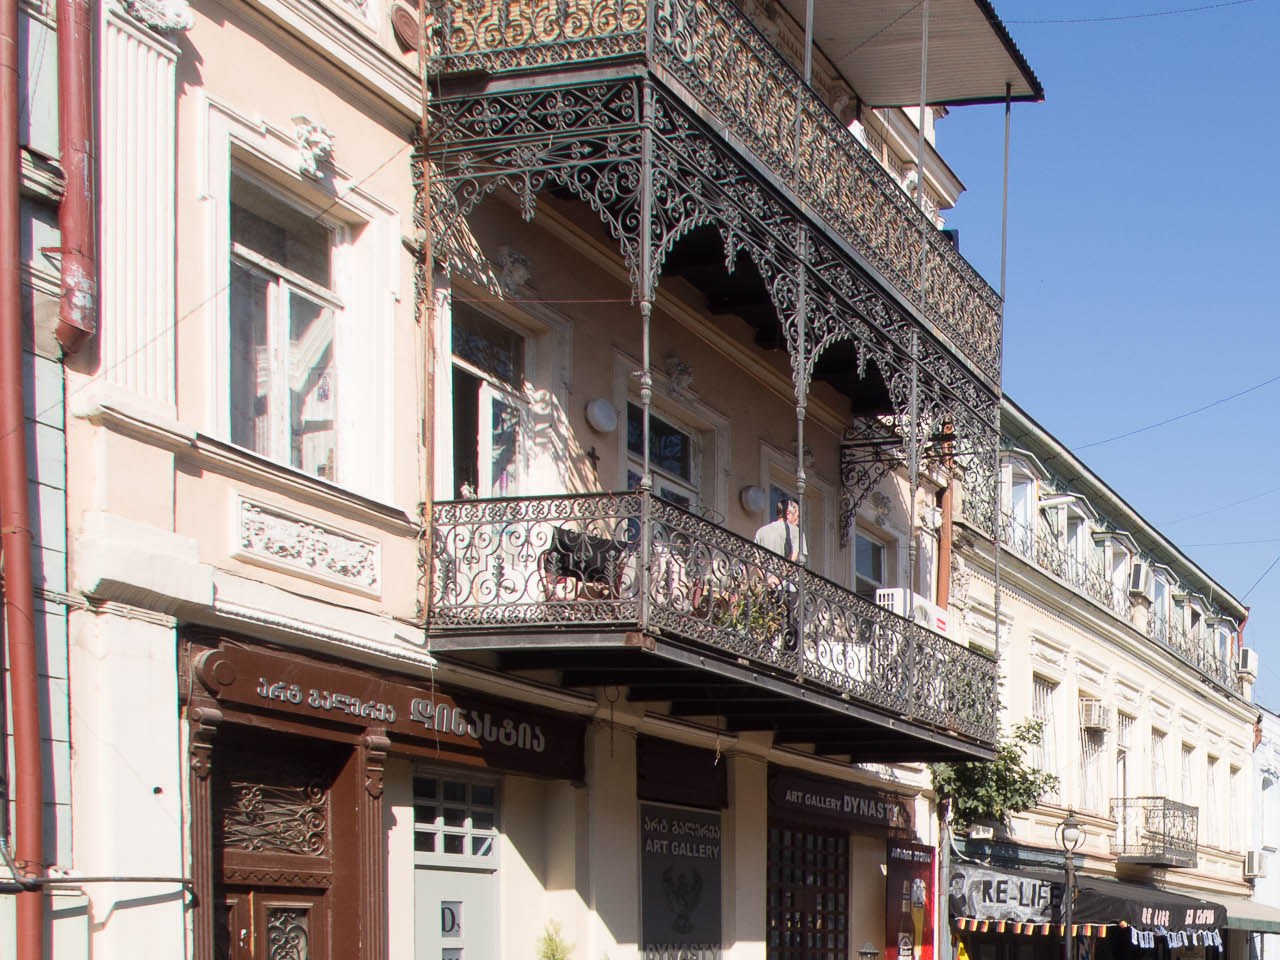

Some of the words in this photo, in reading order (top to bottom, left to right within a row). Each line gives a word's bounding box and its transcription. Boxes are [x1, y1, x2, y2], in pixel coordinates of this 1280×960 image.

[256, 677, 302, 704] არტ
[308, 689, 397, 722] გალერეა
[410, 697, 545, 752] დინასტია
[785, 789, 803, 803] ART
[804, 793, 842, 811] GALLERY
[843, 794, 900, 823] DYNASTY
[645, 837, 669, 855] ART
[671, 840, 720, 860] GALLERY
